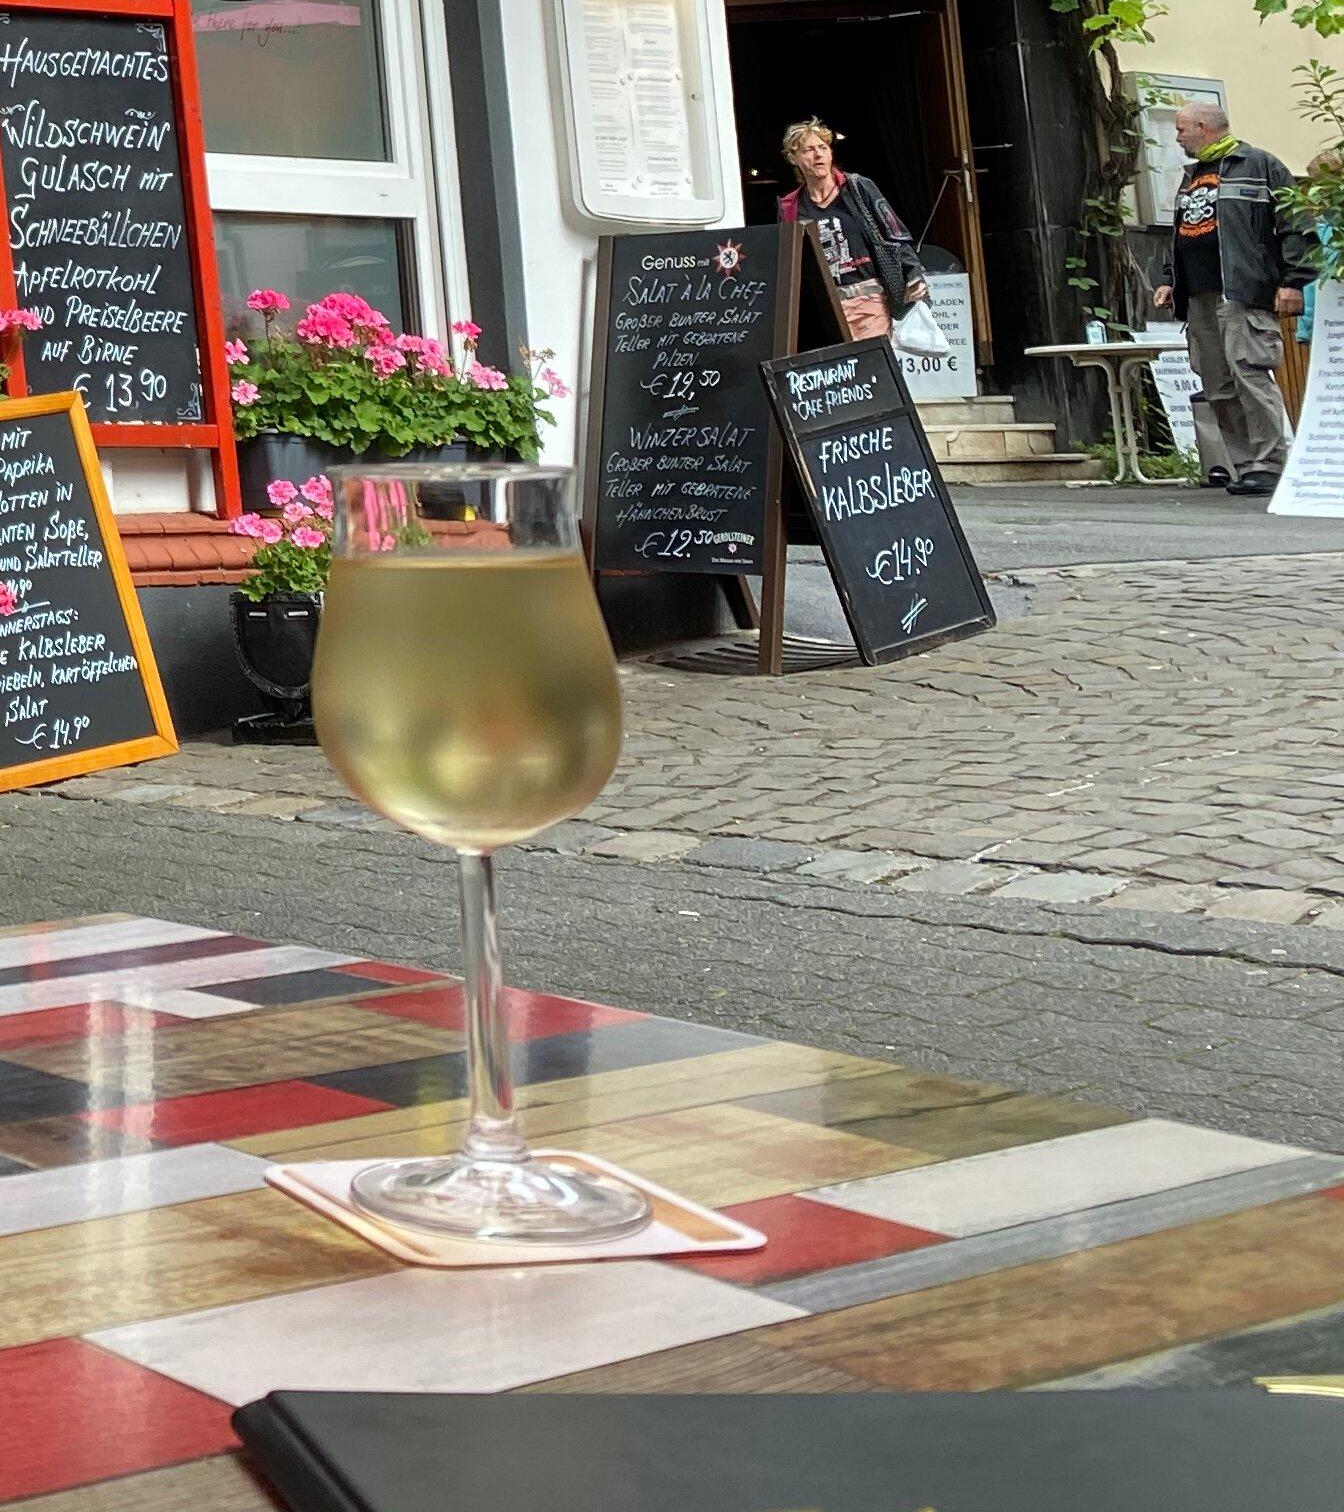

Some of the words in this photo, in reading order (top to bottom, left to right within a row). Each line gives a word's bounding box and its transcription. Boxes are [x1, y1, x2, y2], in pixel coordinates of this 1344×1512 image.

[2, 100, 170, 152] WILDSCHWEIN
[15, 154, 131, 200] GULASCH
[641, 255, 697, 271] Genuss
[622, 275, 678, 307] SALAT
[65, 295, 189, 334] PREISELBEERE
[41, 340, 73, 362] AUF
[77, 334, 139, 365] BIRNE
[947, 356, 958, 372] €
[786, 358, 859, 401] RESTAURANT
[1, 427, 32, 451] MIT
[819, 427, 893, 474] FRISCHE
[56, 481, 73, 502] IN
[822, 461, 936, 522] KALBSLEBER
[0, 556, 22, 572] UND
[24, 542, 103, 573] SALATTELLER
[18, 631, 106, 662] KALBSLEBER
[4, 694, 49, 727] SALAT
